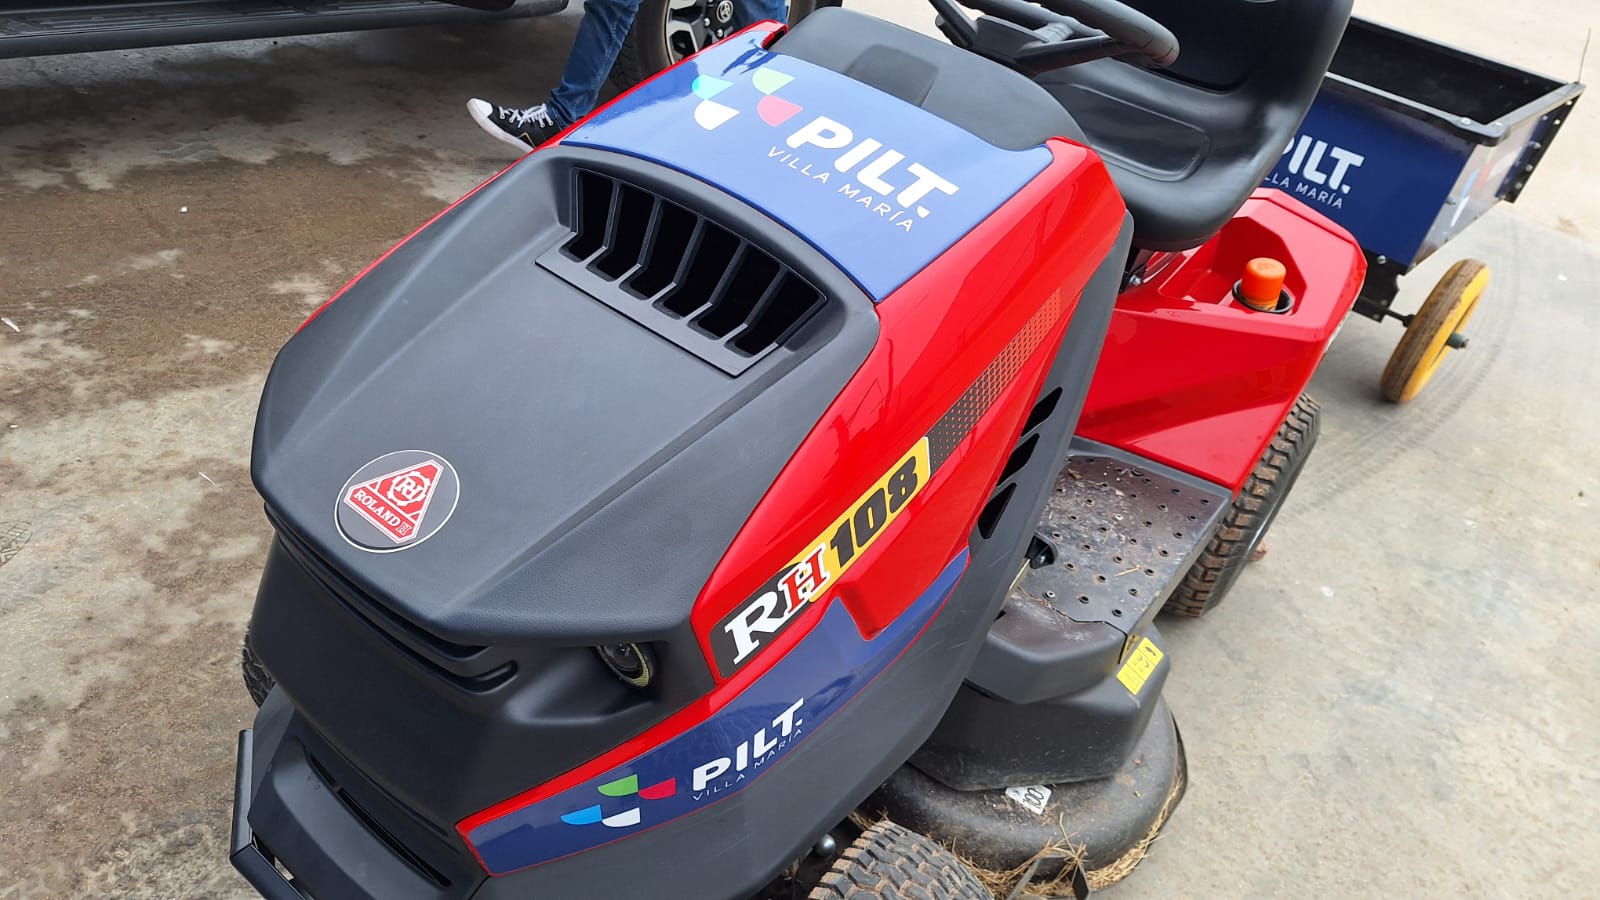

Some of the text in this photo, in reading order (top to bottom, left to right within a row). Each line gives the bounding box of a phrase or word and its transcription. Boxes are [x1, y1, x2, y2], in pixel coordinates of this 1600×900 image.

[768, 146, 913, 233] VILLA MARÍA
[786, 116, 959, 219] PILT.
[1282, 134, 1365, 194] ILT.
[1295, 182, 1344, 209] MARÍA
[353, 489, 401, 527] ROLAND
[724, 455, 918, 665] RH 108
[692, 697, 804, 791] PILT.
[692, 728, 803, 801] VILLA MARÍA
